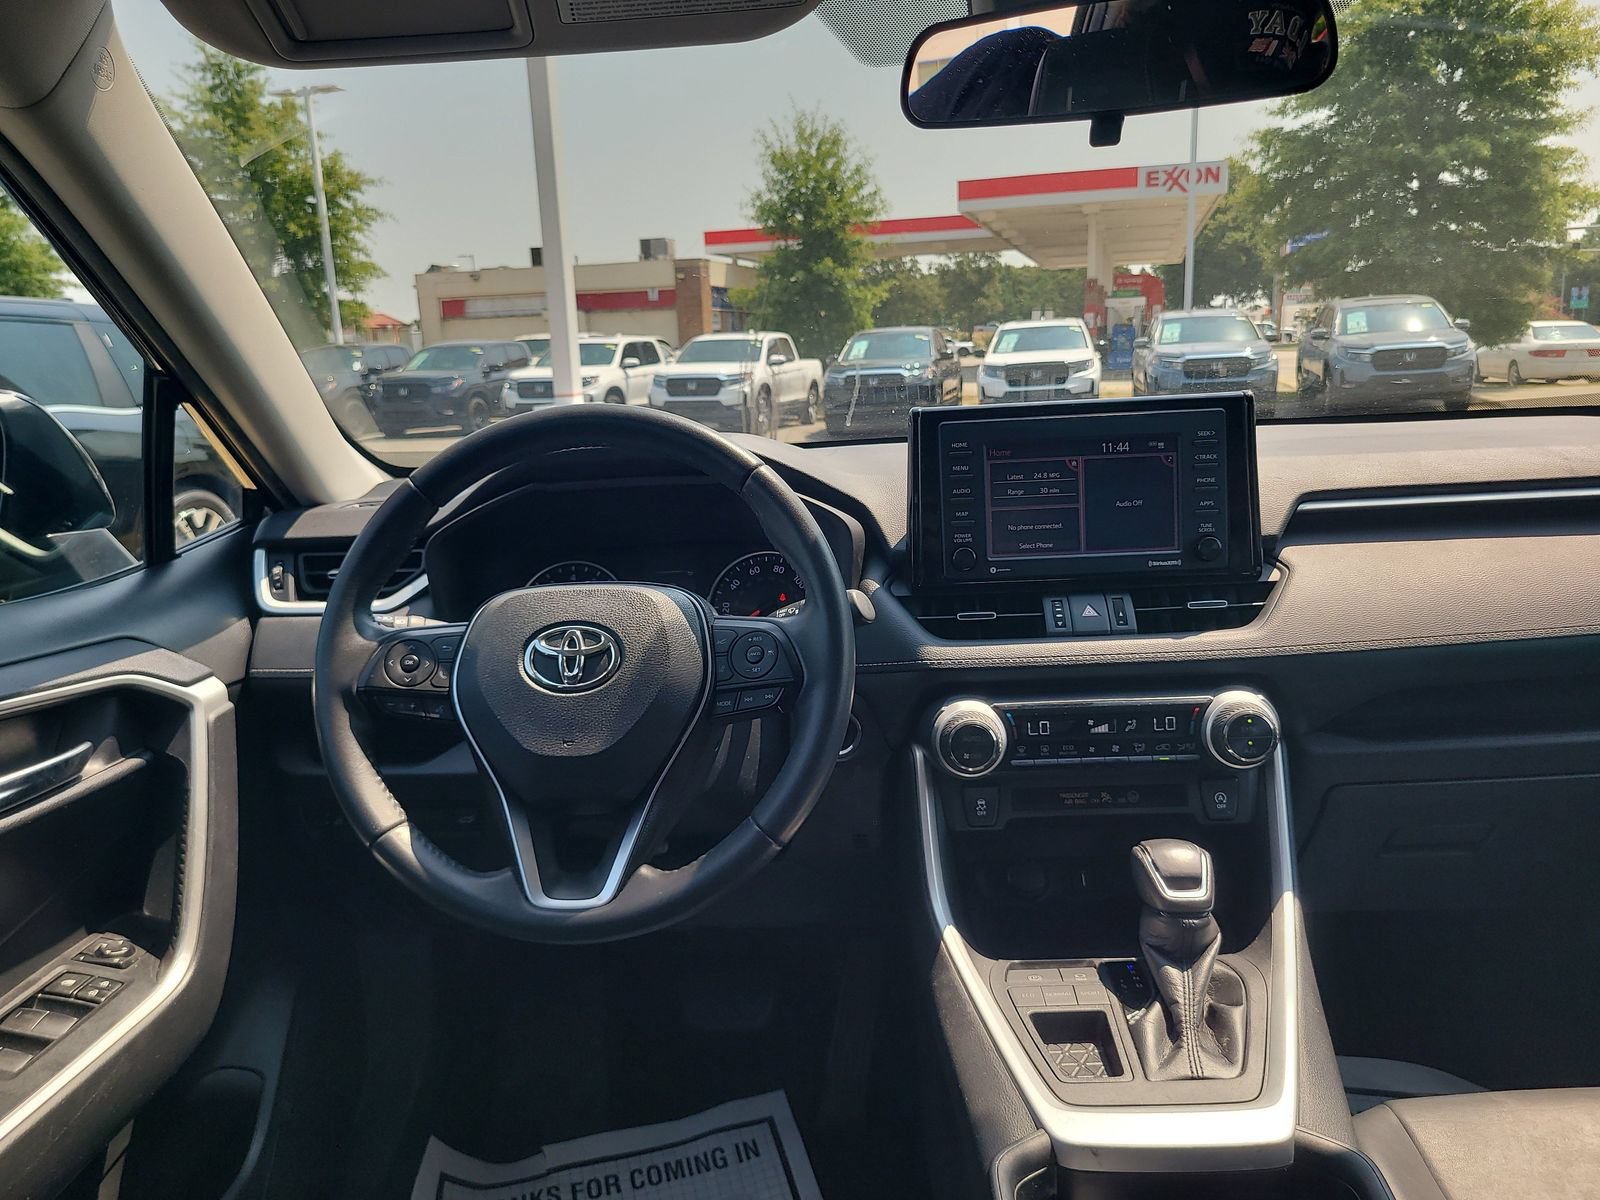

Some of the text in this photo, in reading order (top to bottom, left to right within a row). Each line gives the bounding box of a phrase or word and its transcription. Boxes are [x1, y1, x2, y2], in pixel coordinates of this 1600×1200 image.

[1145, 166, 1221, 193] EXXON
[989, 449, 1012, 457] Home
[1101, 441, 1130, 453] 11:44
[1017, 524, 1033, 532] phone
[1036, 541, 1054, 549] Phone
[749, 566, 761, 576] 60
[772, 564, 785, 575] 80
[729, 578, 741, 592] 40
[792, 575, 805, 589] 100
[722, 602, 731, 616] 20
[571, 1173, 622, 1200] FOR
[630, 1147, 728, 1189] COMING
[735, 1138, 761, 1163] IN
